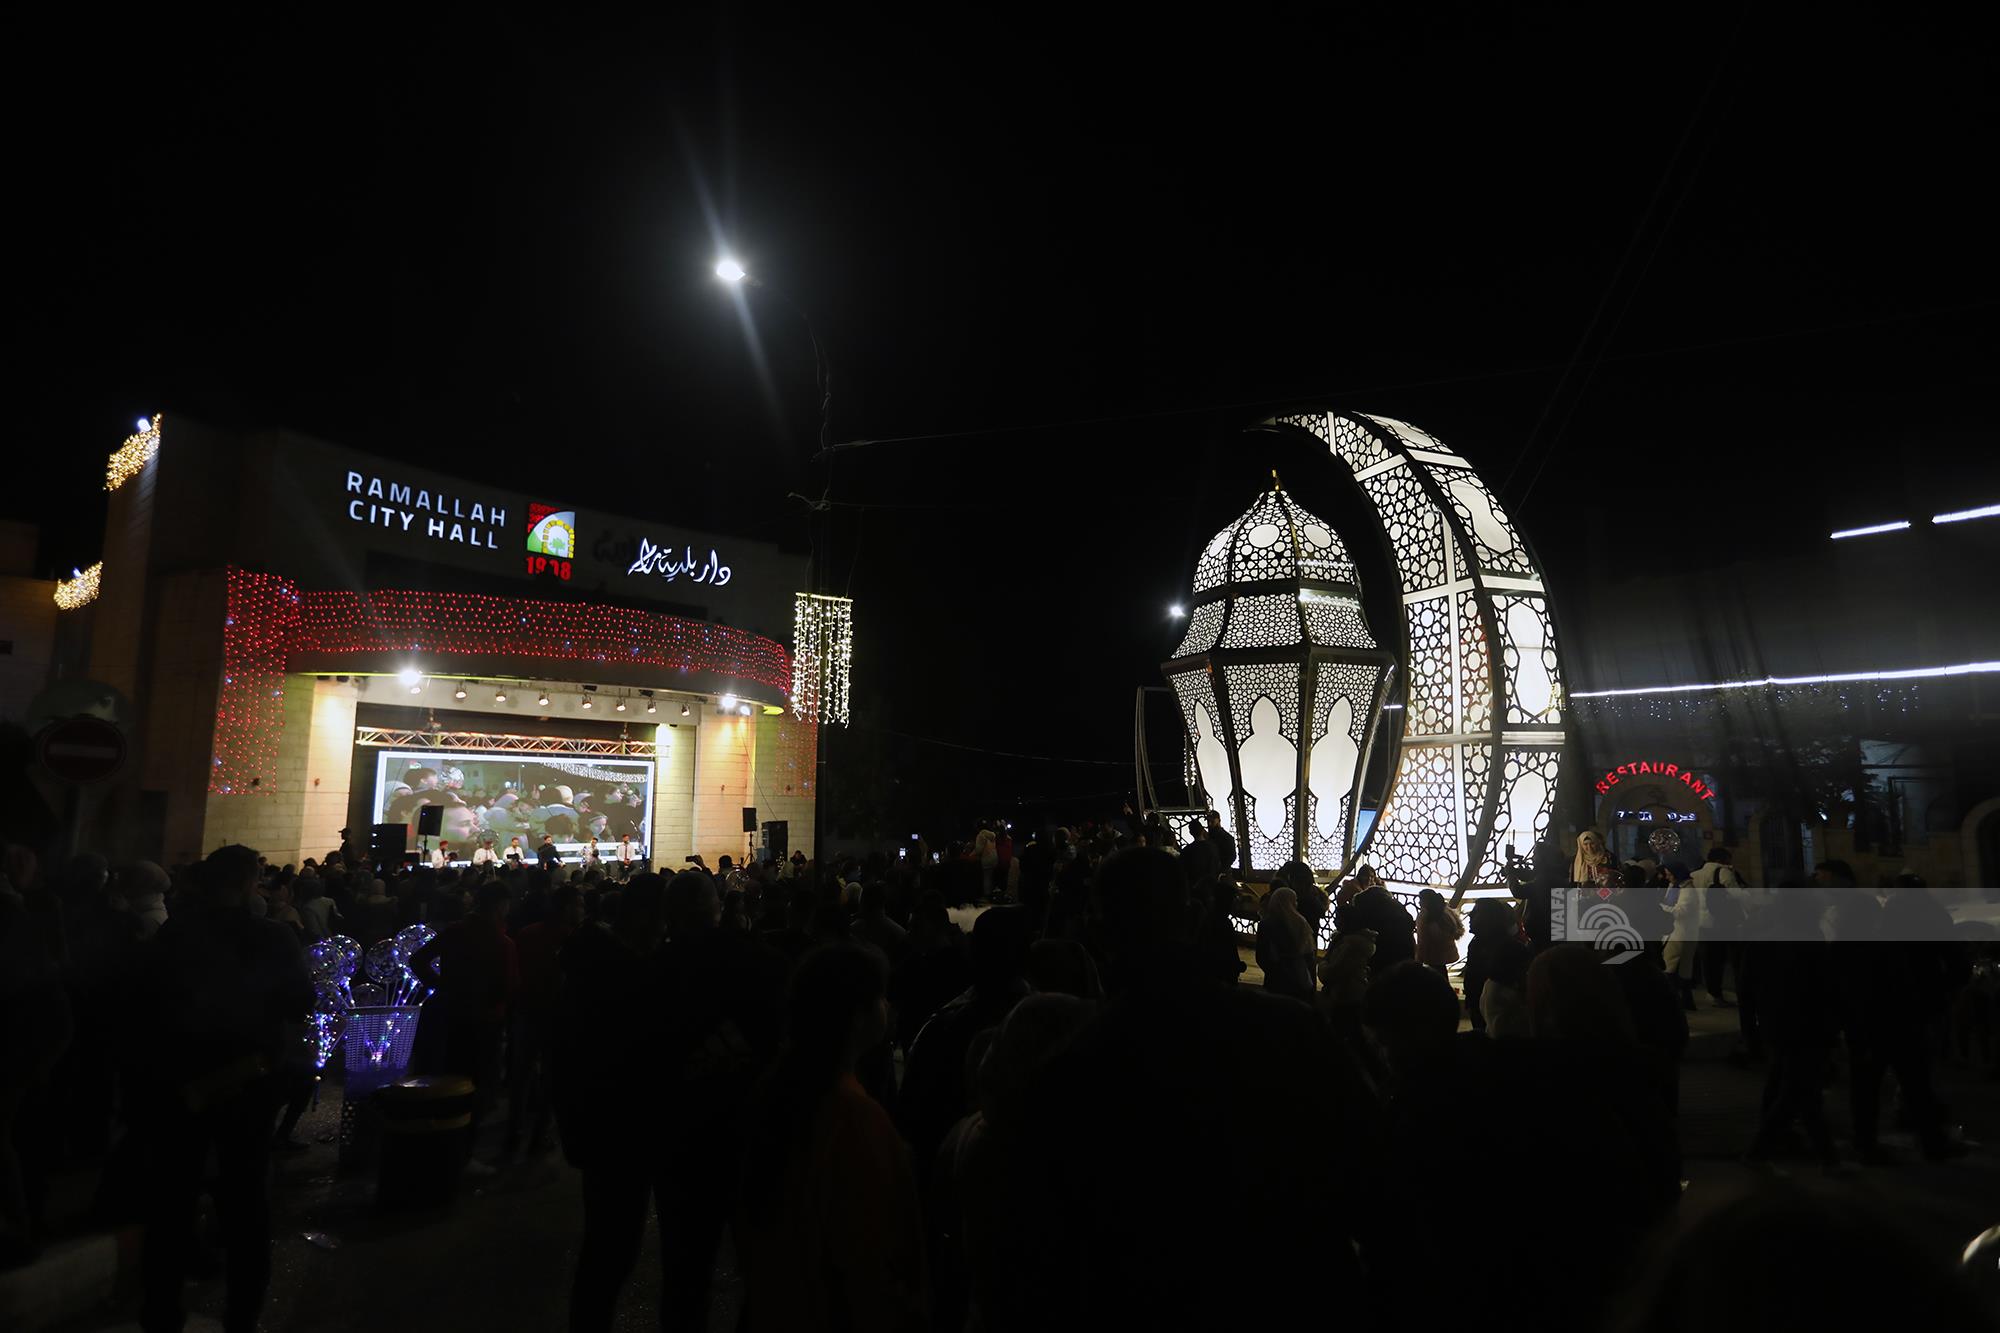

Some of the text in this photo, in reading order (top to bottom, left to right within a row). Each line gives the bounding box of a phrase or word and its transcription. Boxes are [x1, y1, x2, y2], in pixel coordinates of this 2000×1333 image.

[346, 470, 506, 528] RAMALLAH
[348, 499, 498, 549] CITY HALL
[693, 549, 732, 587] دار
[1596, 760, 1715, 801] RESTAURANT
